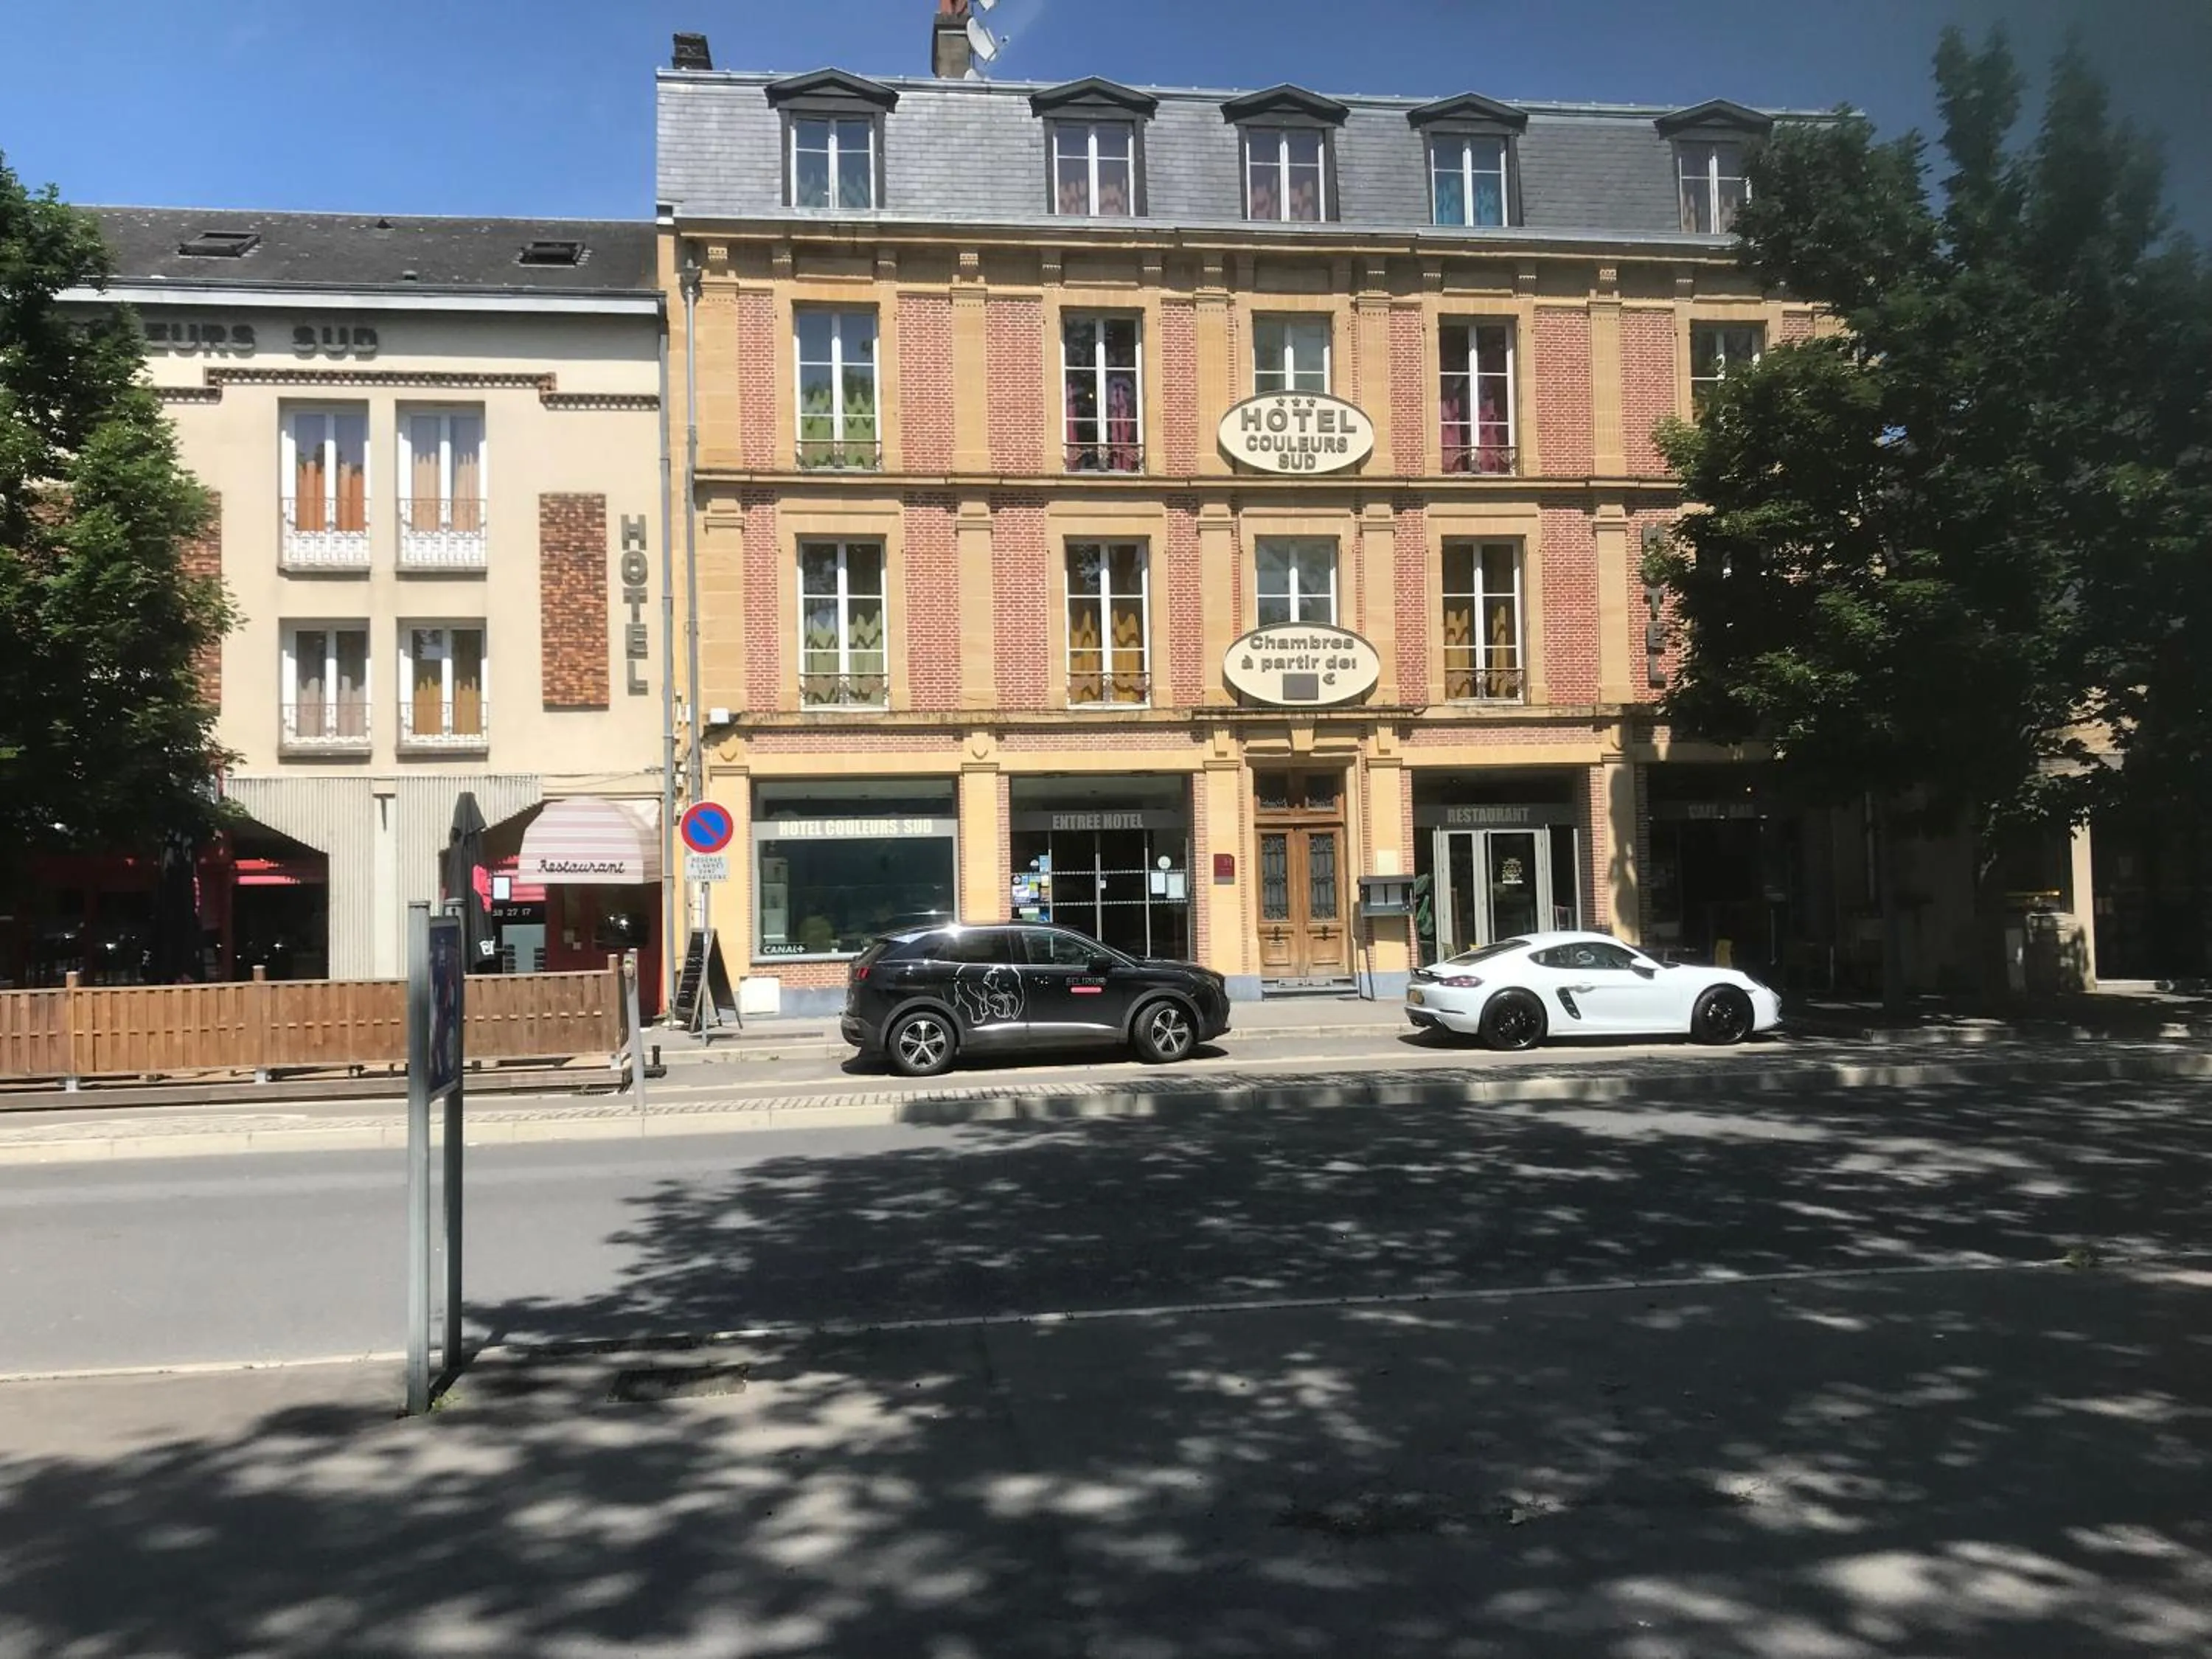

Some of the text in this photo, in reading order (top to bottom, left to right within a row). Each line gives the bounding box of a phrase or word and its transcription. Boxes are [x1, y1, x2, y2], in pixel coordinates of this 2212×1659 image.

[145, 322, 378, 357] EURS SUD
[1240, 407, 1357, 434] HOTEL
[1245, 434, 1349, 453] COULEURS
[1278, 453, 1317, 470] SUD
[620, 514, 649, 696] HOTEL
[1641, 520, 1667, 689] HTEL
[1249, 635, 1355, 650] Chambres
[1260, 654, 1321, 672] partir
[1052, 813, 1144, 830] ENTREE HOTEL
[1447, 807, 1530, 823] RESTAURANT
[778, 818, 933, 836] HOTEL COULEURS SUD
[537, 860, 626, 874] Restaurant
[507, 908, 518, 917] 27
[763, 945, 806, 954] CANAL+
